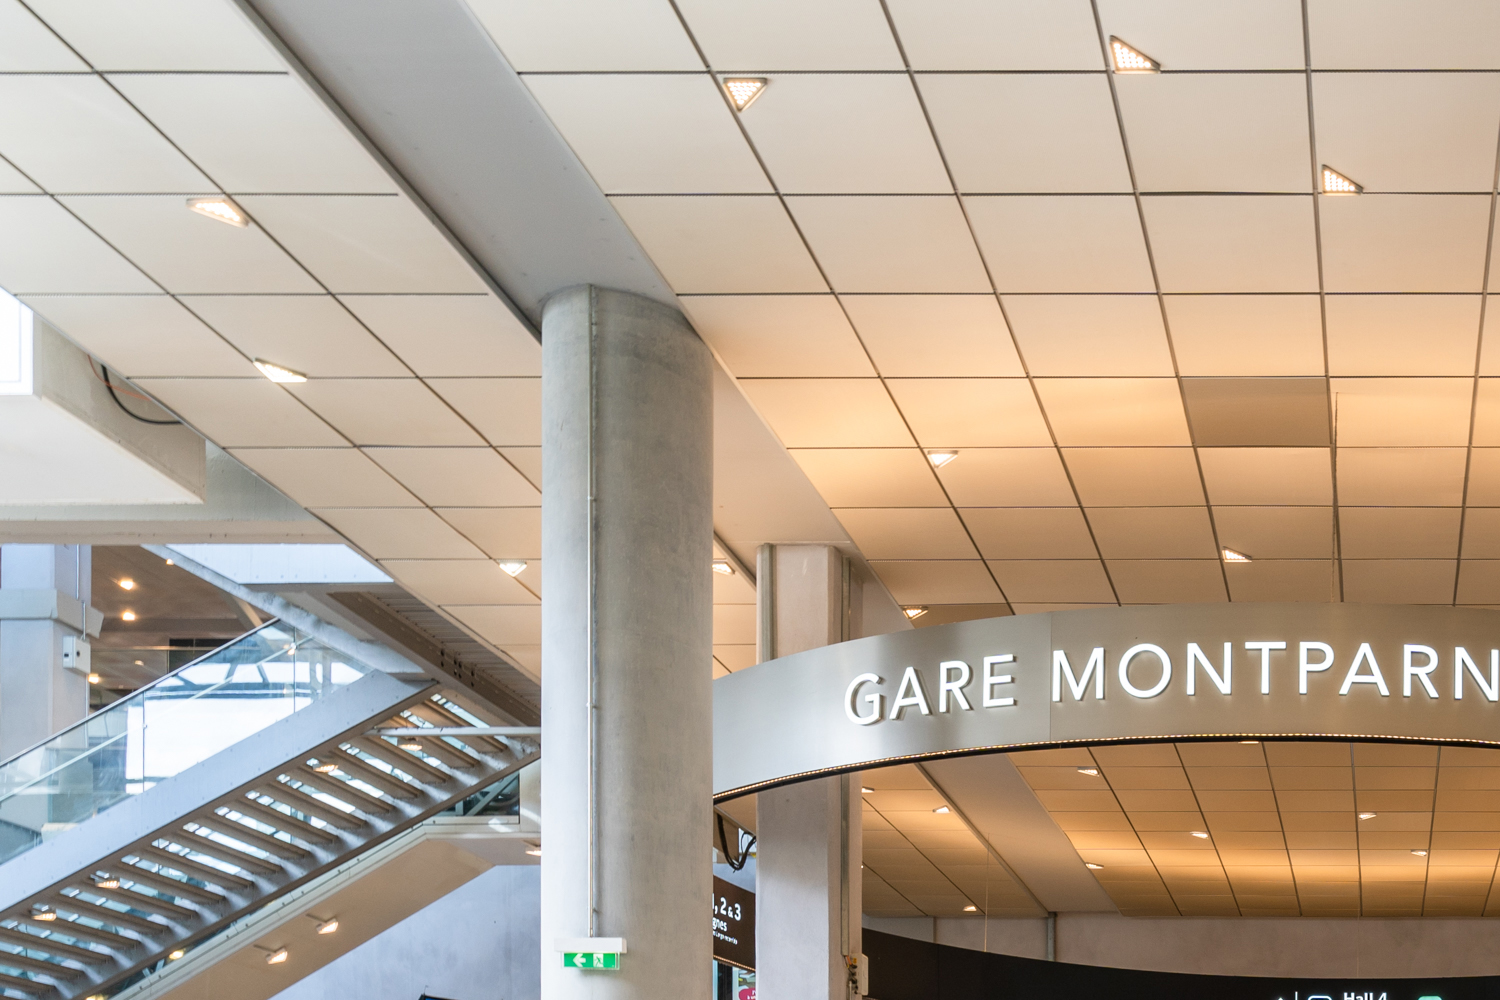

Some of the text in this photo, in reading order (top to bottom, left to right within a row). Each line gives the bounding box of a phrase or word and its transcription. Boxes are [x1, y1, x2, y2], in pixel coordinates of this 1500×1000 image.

[843, 653, 1018, 728] GARE
[720, 897, 727, 916] 2
[734, 903, 742, 921] 3
